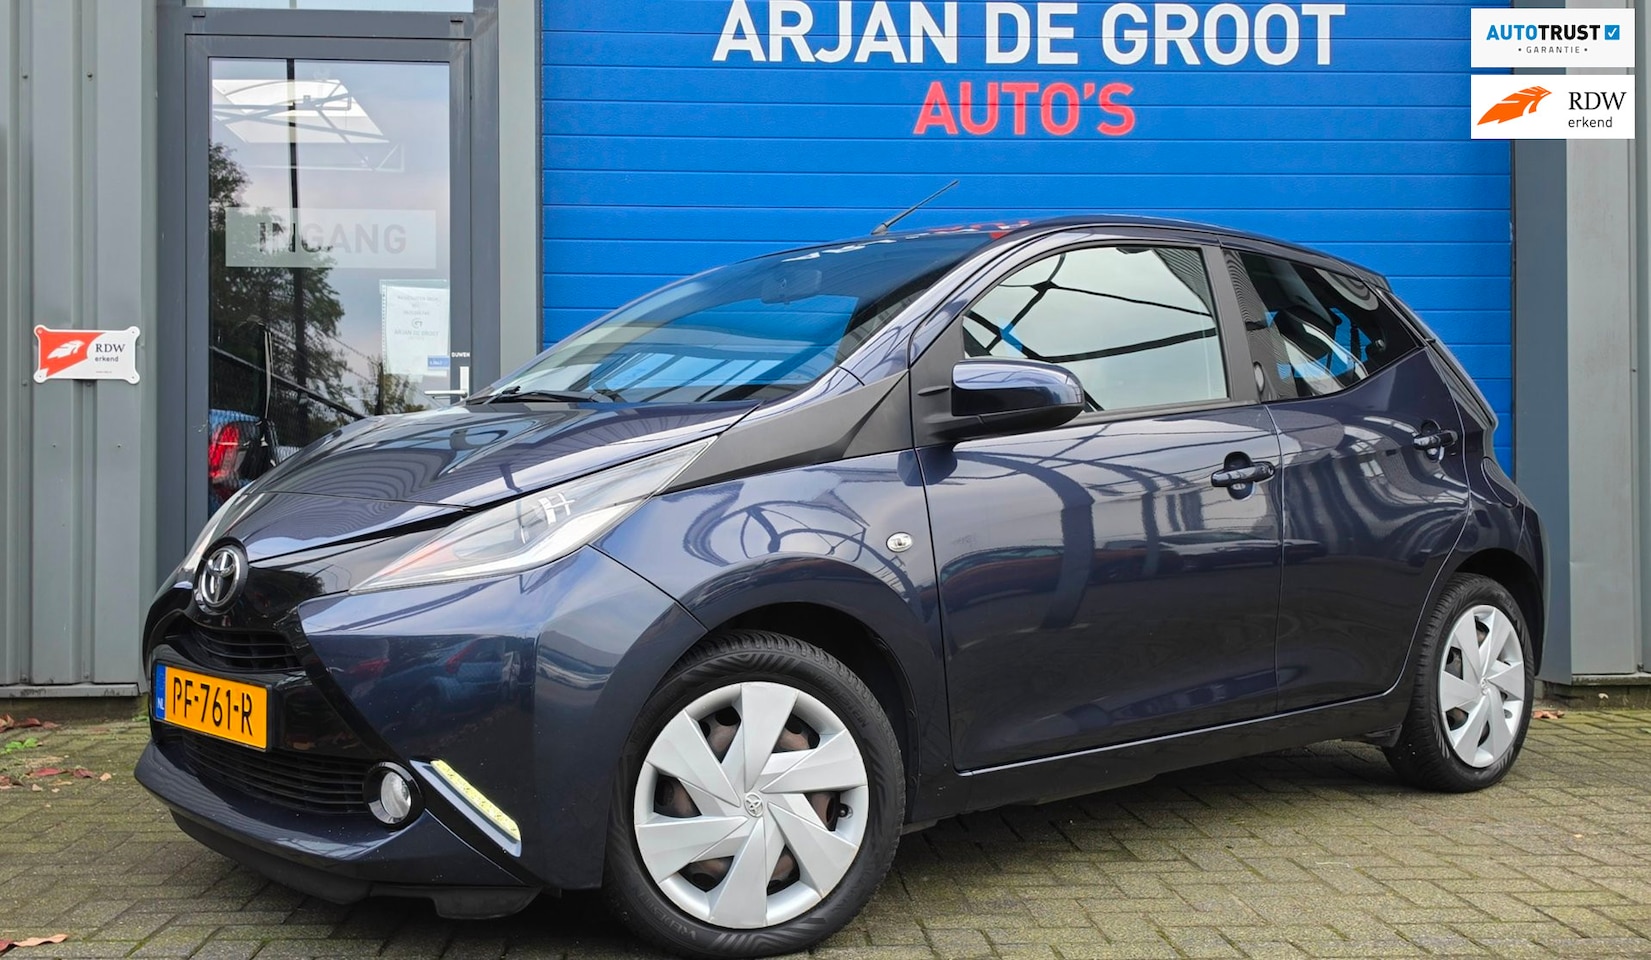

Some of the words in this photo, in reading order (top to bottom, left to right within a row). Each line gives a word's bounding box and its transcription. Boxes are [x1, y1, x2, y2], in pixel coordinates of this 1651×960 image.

[713, 0, 957, 64] ARJAN
[986, 3, 1078, 64] DE
[1103, 3, 1346, 66] GROOT
[913, 81, 1136, 136] AUTO'S
[258, 221, 407, 255] INGANG
[95, 343, 126, 353] RDW
[157, 696, 165, 711] NL
[173, 676, 253, 736] PF-761-R
